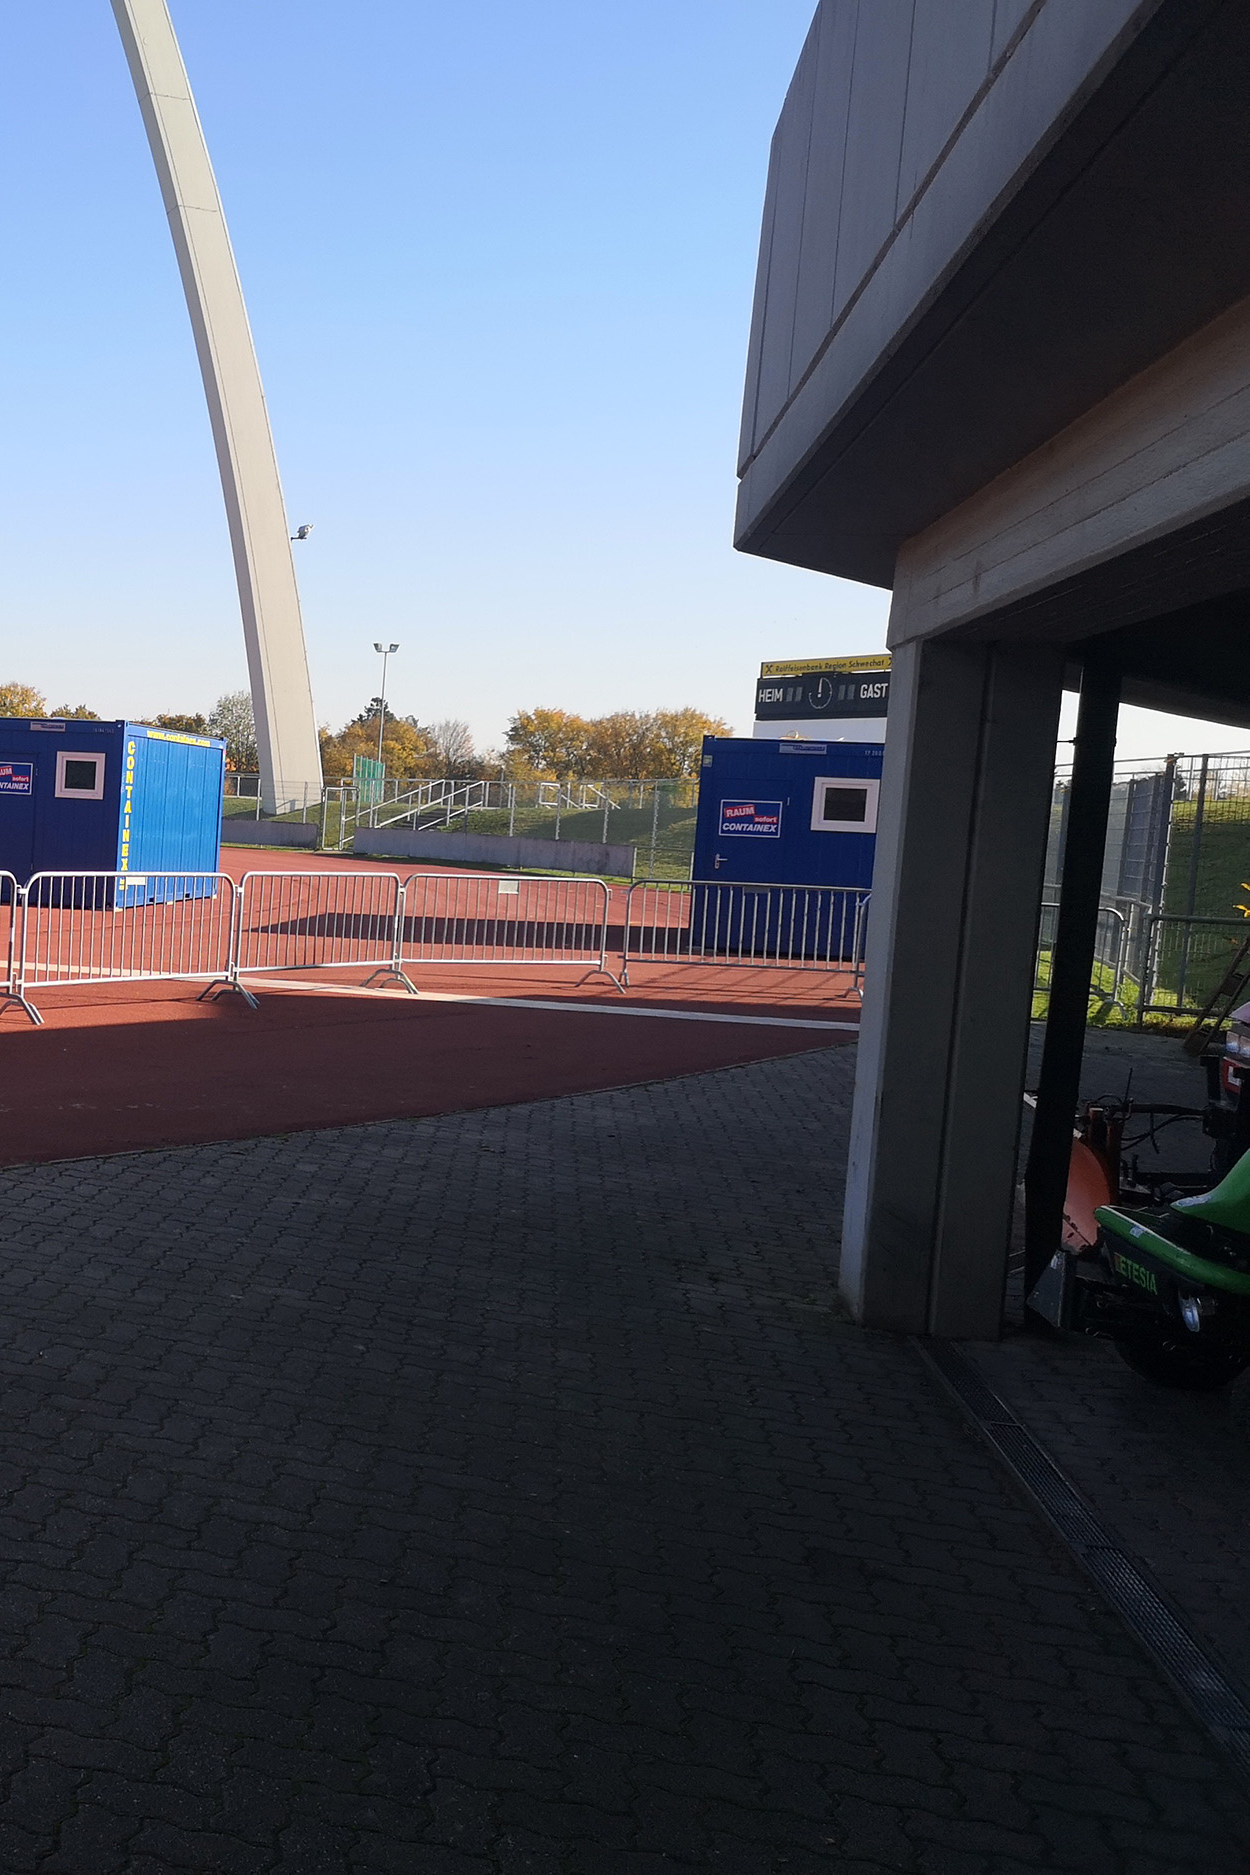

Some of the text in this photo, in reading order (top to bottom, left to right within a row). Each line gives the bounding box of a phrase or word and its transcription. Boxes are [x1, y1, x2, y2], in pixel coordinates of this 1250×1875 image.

[775, 659, 885, 673] Raiffeisenbank Region Schwechat
[758, 688, 784, 703] HEIM
[860, 683, 889, 699] GAST
[121, 741, 136, 871] CONTAINEX
[726, 807, 755, 818] RAUM
[723, 822, 777, 833] CONTAINEX
[1120, 1256, 1158, 1296] ETESIA
